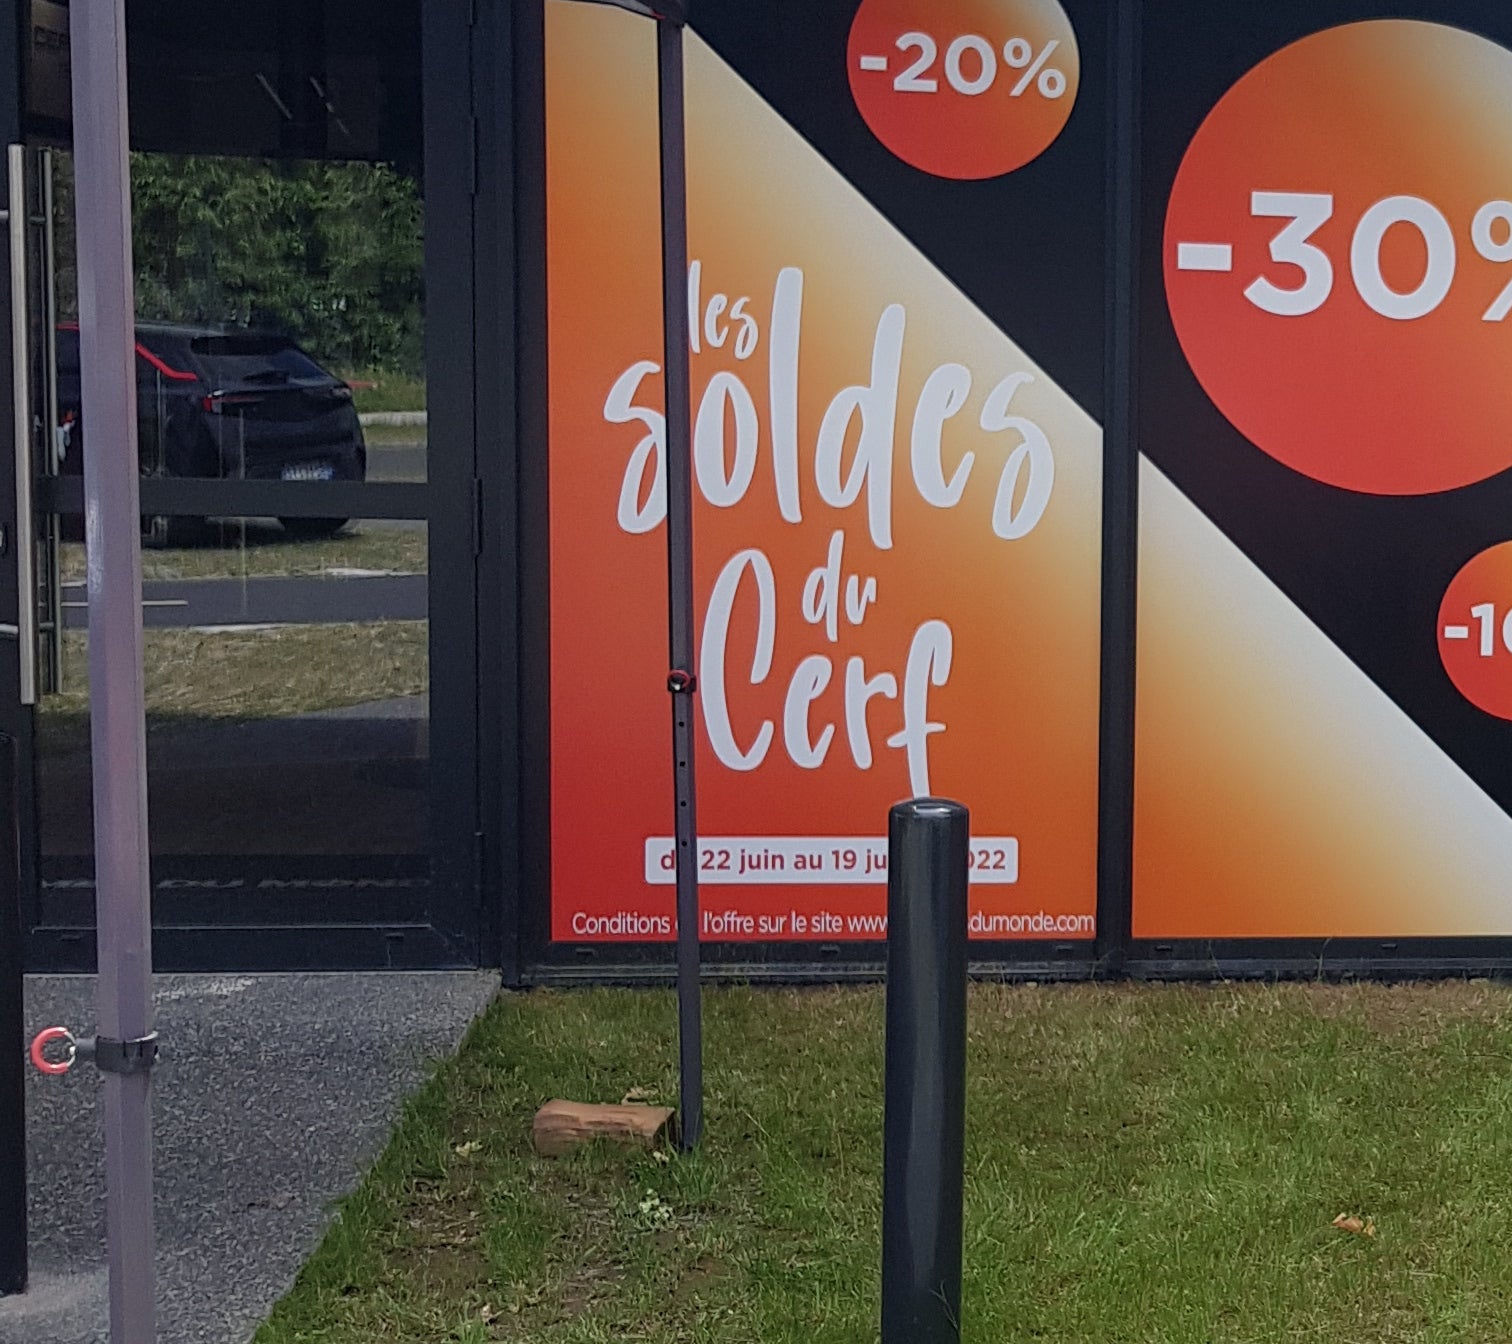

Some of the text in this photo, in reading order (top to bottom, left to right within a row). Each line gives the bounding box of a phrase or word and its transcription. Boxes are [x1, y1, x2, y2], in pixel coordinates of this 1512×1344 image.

[859, 31, 1067, 99] -20%
[688, 260, 758, 360] les
[802, 529, 876, 642] du
[700, 548, 953, 799] Cerf
[701, 849, 731, 871] 22
[738, 848, 785, 874] juin
[793, 853, 823, 871] au
[831, 849, 857, 871] 19
[572, 911, 671, 934] Conditions
[703, 910, 755, 933] l'offre
[758, 915, 787, 933] sur
[791, 909, 807, 932] le
[811, 910, 843, 933] site
